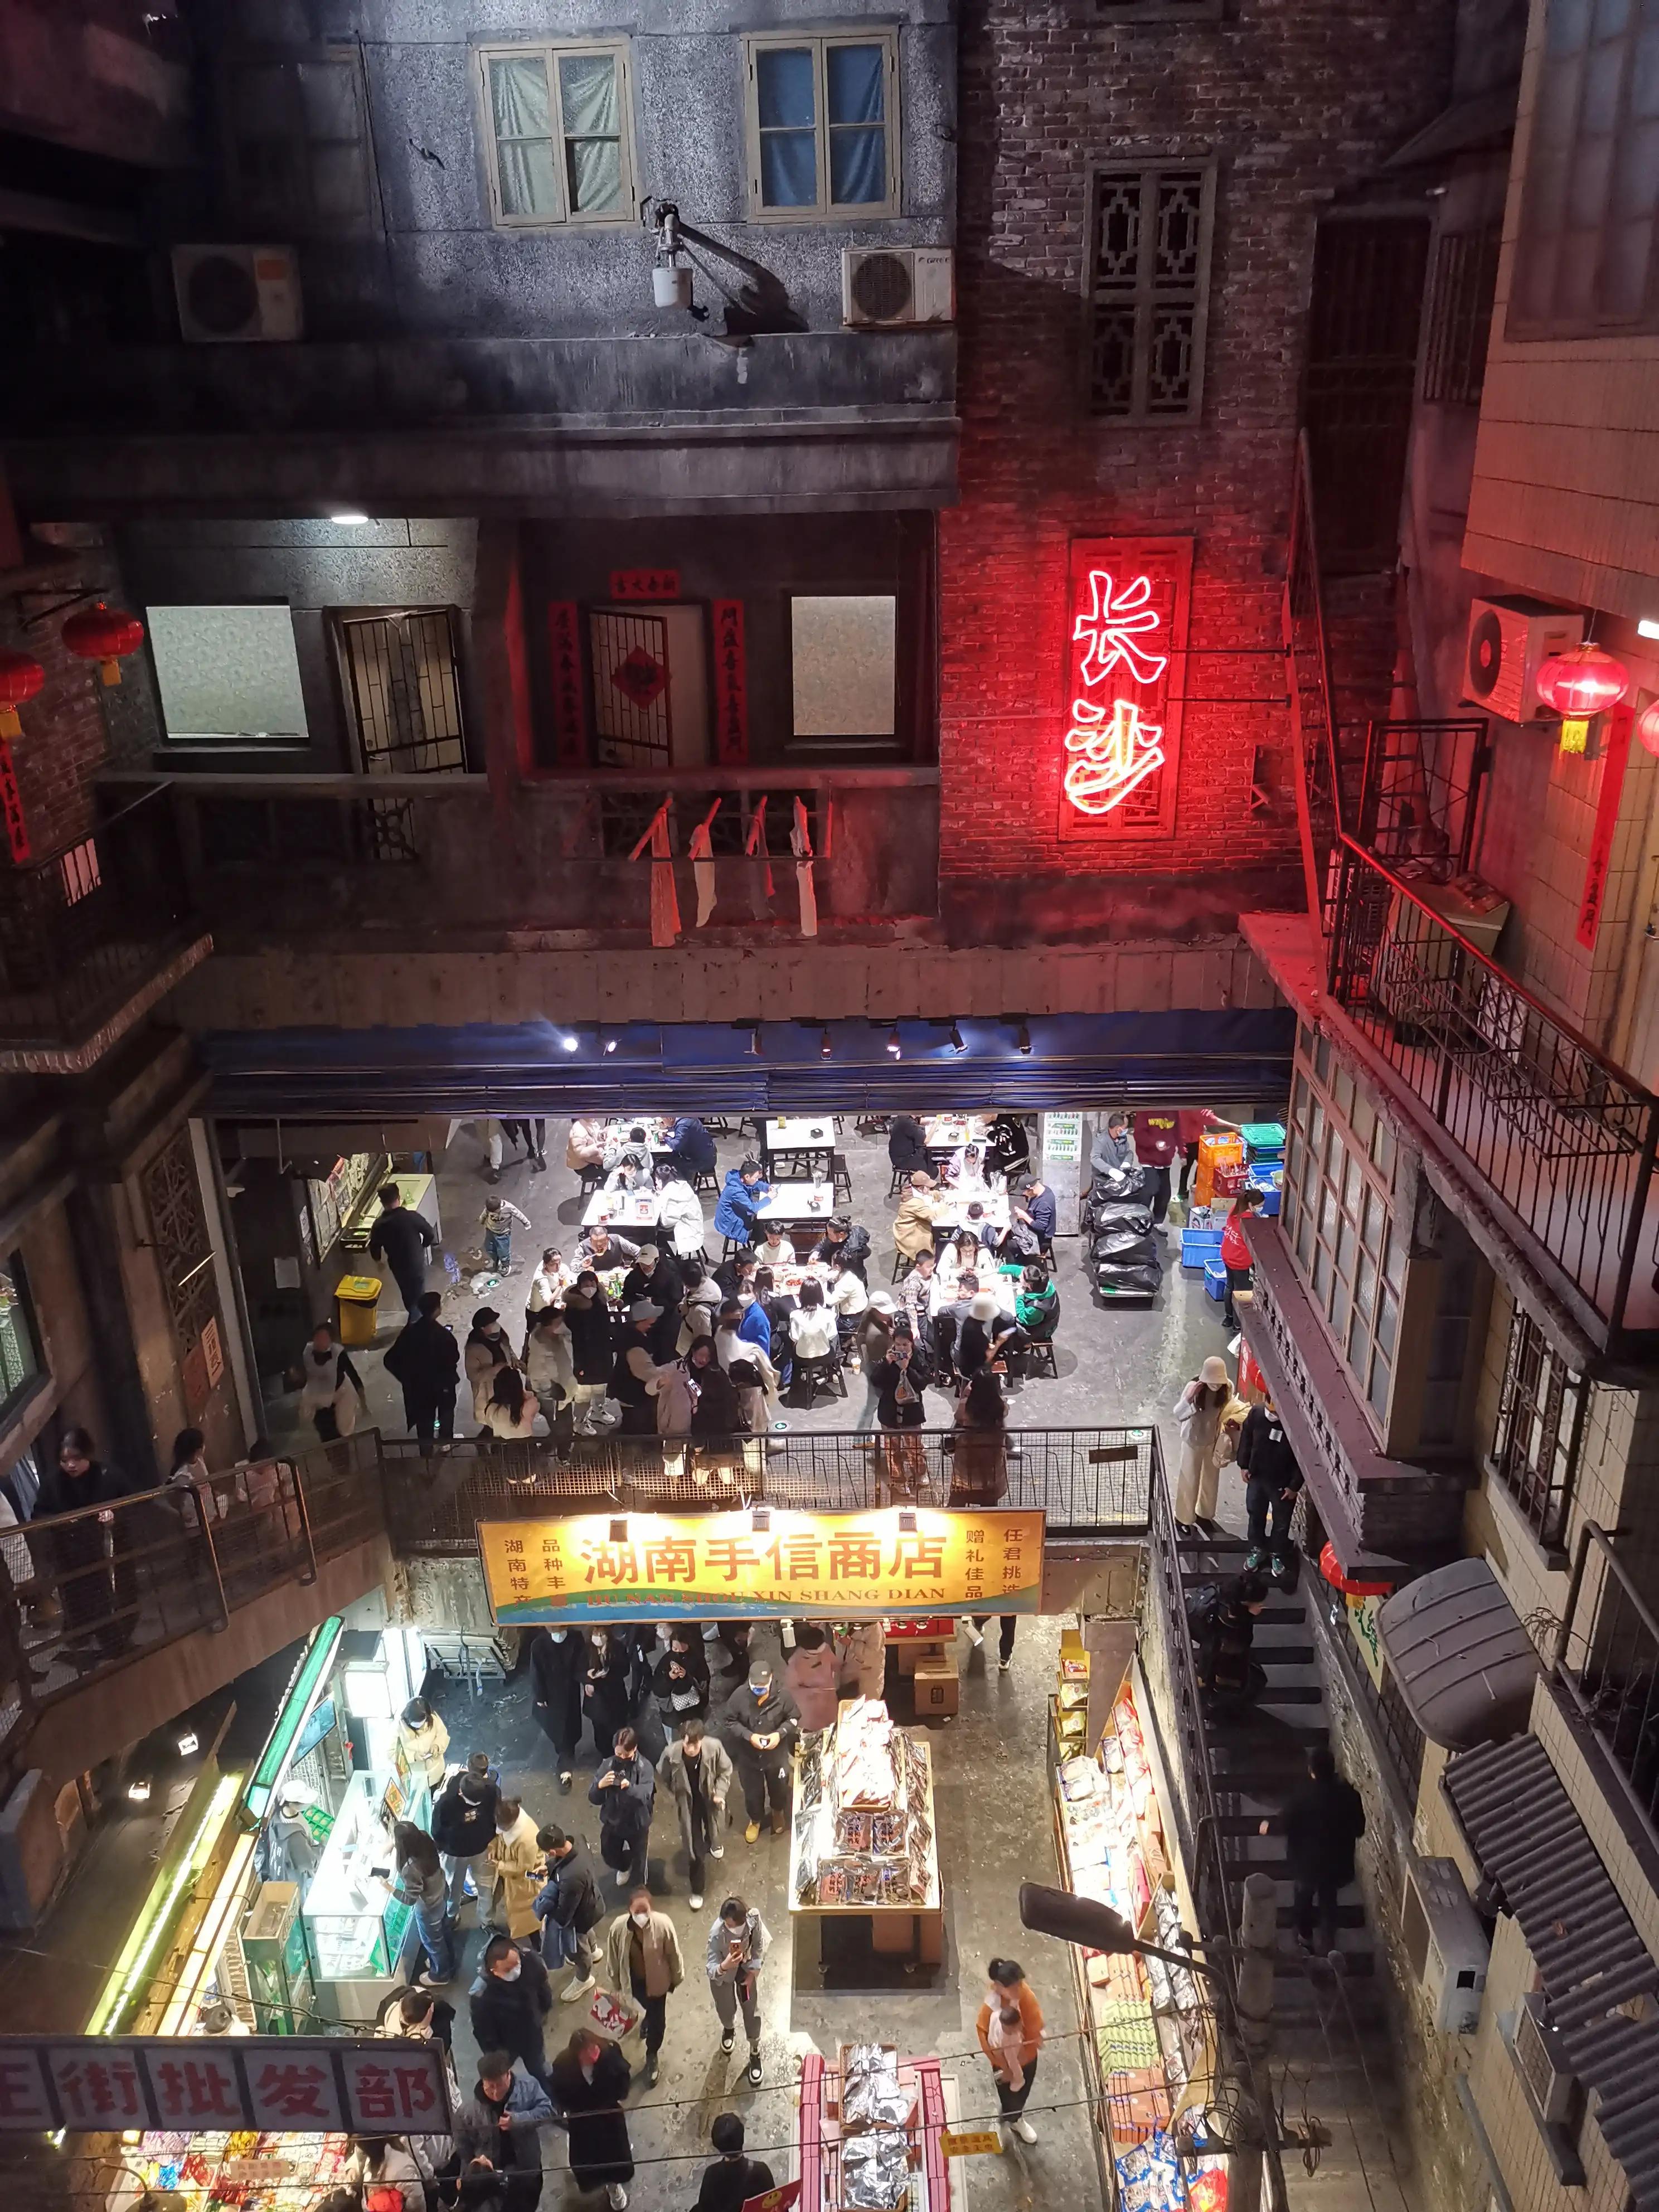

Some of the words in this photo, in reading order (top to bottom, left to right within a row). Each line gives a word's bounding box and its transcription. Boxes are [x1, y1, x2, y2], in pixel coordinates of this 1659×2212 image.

[1064, 569, 1166, 814] 长沙
[505, 1539, 531, 1608] 湖南特产
[580, 1530, 947, 1585] 湖南手信商店
[965, 1530, 986, 1598] 赠礼佳品
[1002, 1529, 1024, 1598] 任君挑选
[587, 1594, 617, 1606] HU
[626, 1593, 675, 1605] NAN
[681, 1592, 744, 1604] SHOU
[753, 1590, 792, 1602] XIN
[801, 1589, 880, 1601] SHANG
[889, 1588, 946, 1599] DIAN
